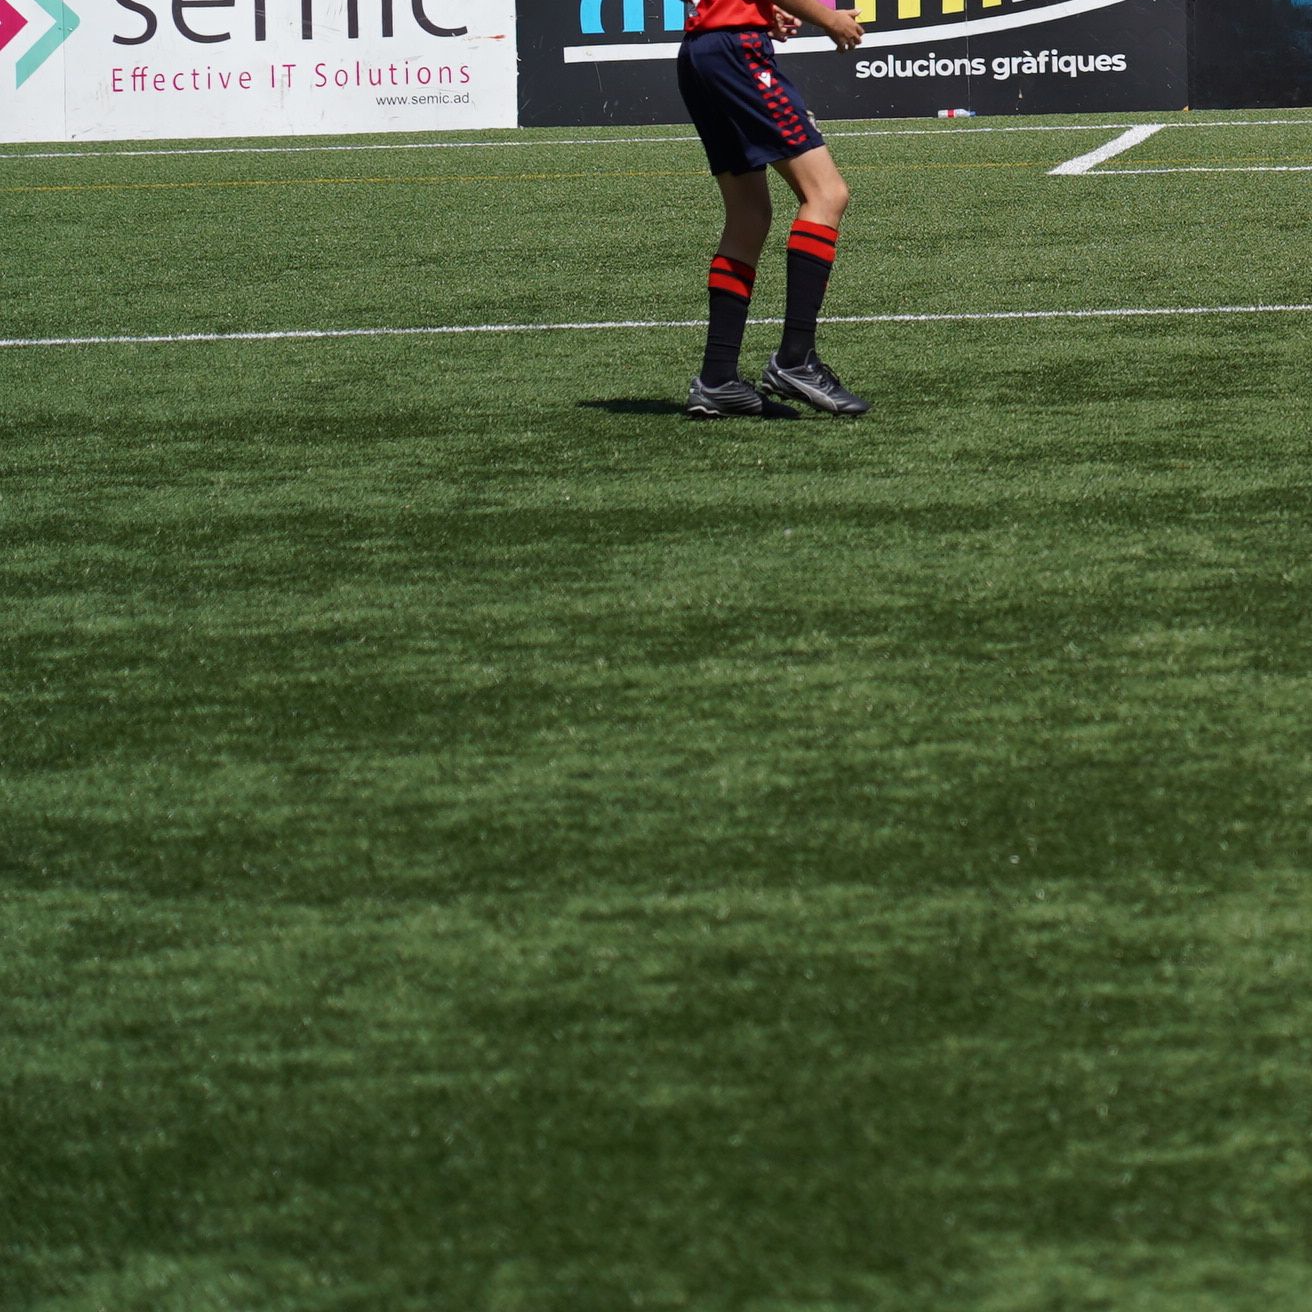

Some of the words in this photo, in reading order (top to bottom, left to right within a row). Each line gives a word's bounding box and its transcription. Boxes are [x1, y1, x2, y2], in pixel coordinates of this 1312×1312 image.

[111, 67, 253, 92] Effective
[270, 64, 297, 89] IT
[314, 60, 471, 88] Solutions
[855, 52, 987, 79] solucions
[992, 49, 1127, 81] gràfiques
[375, 92, 470, 107] www.semic.ad
